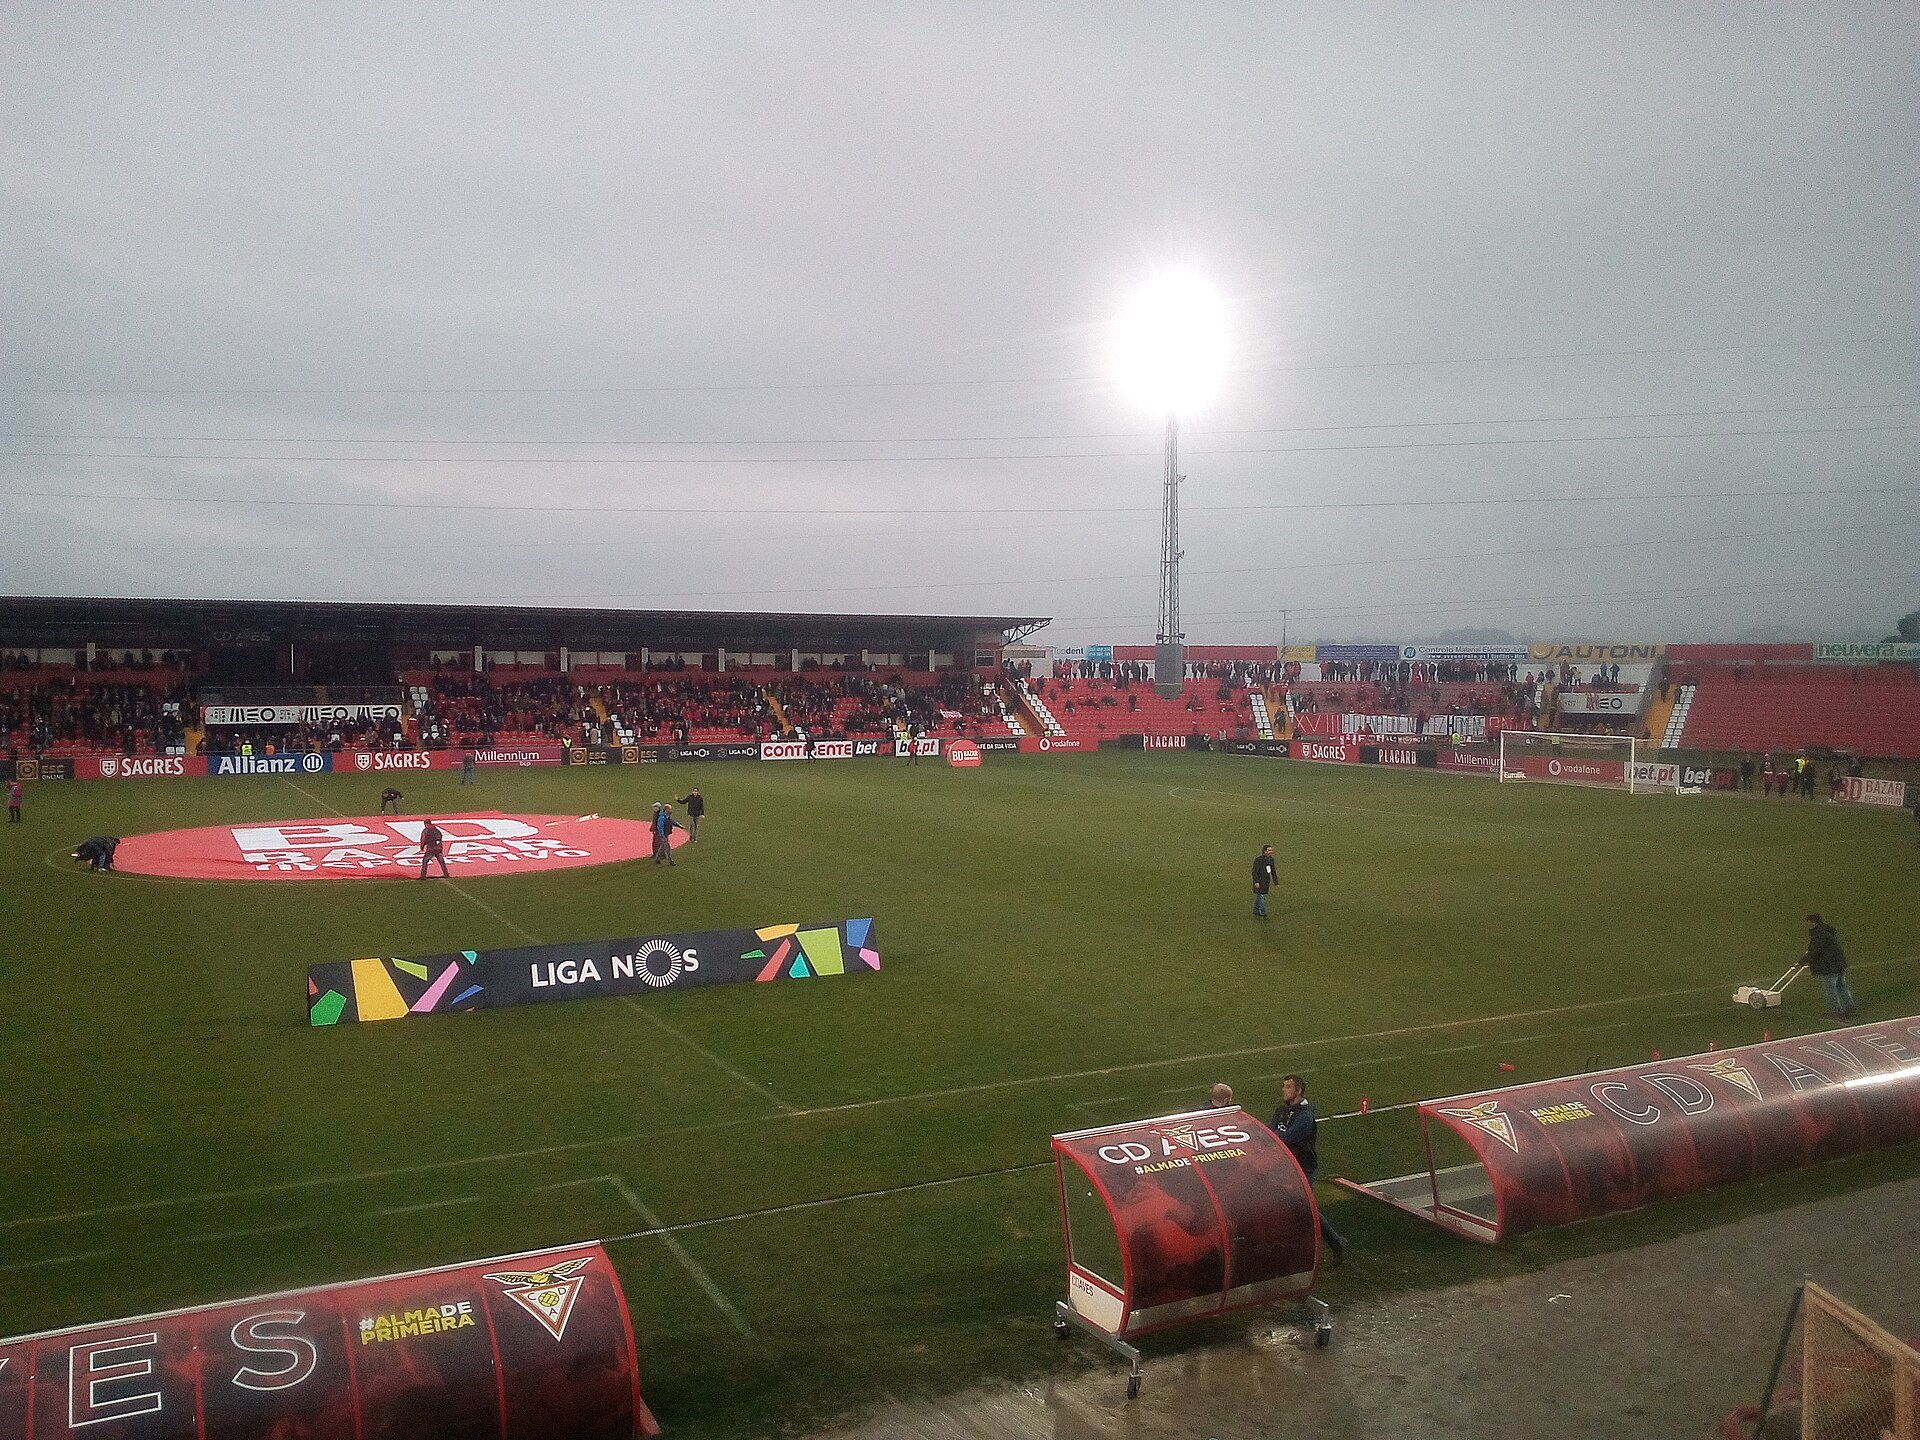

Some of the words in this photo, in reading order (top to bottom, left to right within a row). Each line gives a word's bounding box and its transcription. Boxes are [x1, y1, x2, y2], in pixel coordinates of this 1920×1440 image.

[1818, 643, 1895, 657] neuvera
[900, 739, 936, 755] bt.pt
[1051, 740, 1080, 748] vodafone
[1144, 735, 1186, 748] PLACARD
[475, 750, 540, 761] Millennium
[694, 748, 710, 758] NOS
[742, 747, 758, 757] NOS
[763, 743, 852, 758] CONTIENTE
[952, 751, 964, 761] BD
[1312, 743, 1346, 761] SAGRES
[1378, 749, 1417, 764] PLACARD
[121, 757, 185, 776] SAGRES
[218, 756, 296, 775] Allianz
[374, 751, 431, 770] SAGRES
[1454, 752, 1506, 767] Millennium
[41, 765, 65, 774] ESC
[1563, 765, 1600, 775] vodafone
[1866, 780, 1903, 796] BAZAR
[230, 818, 540, 850] BD
[531, 958, 602, 988] LIGA
[611, 939, 699, 988] NOS
[1590, 1072, 1714, 1125] CD
[1536, 1109, 1596, 1126] PRIMEIRA
[1099, 1142, 1151, 1165] CD
[359, 1301, 473, 1331] #ALMADE
[360, 1313, 476, 1346] PRIMEIRA
[0, 1311, 318, 1428] ES
